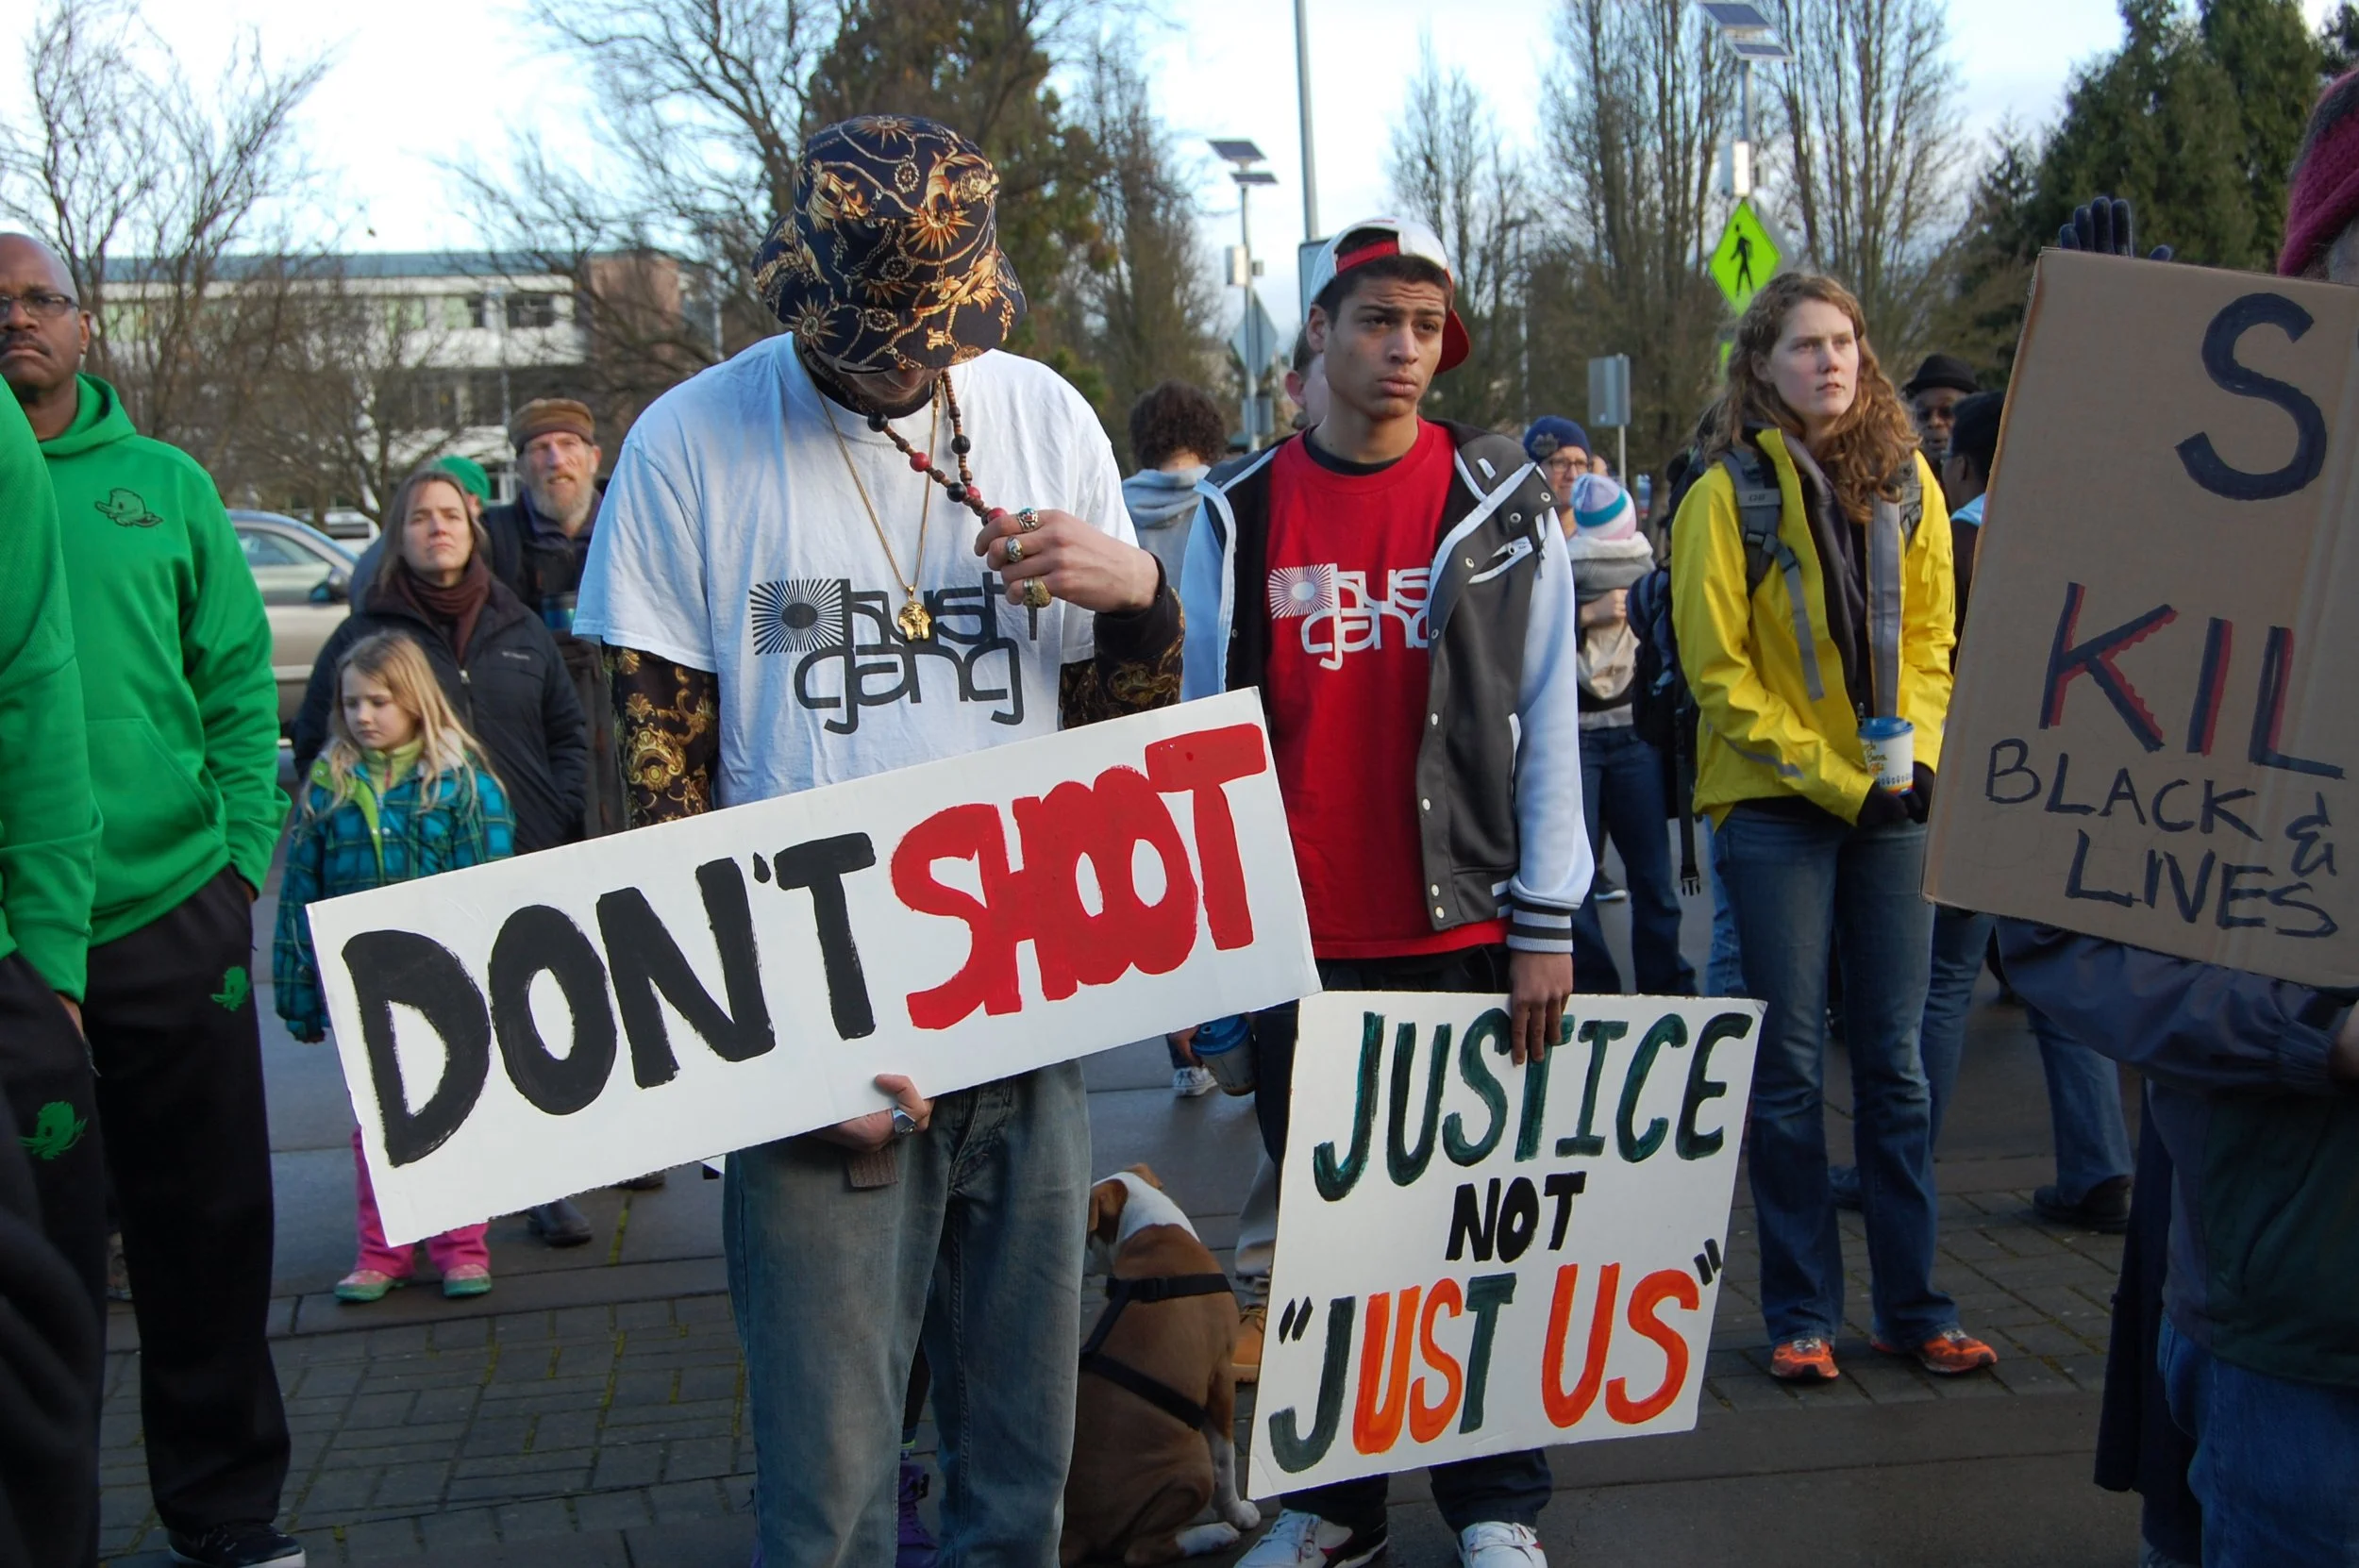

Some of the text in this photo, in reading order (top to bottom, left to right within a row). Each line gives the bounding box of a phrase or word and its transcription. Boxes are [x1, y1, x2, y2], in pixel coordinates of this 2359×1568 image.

[1328, 562, 1431, 611] hus
[794, 637, 1025, 735] gang
[1985, 738, 2264, 842] BLACK
[2064, 827, 2339, 938] LIVES
[341, 722, 1268, 1168] DON'T SHOOT
[1313, 1007, 1753, 1202] JUSTICE
[1445, 1171, 1587, 1264] NOT
[1268, 1238, 1723, 1475] "JUST US"
